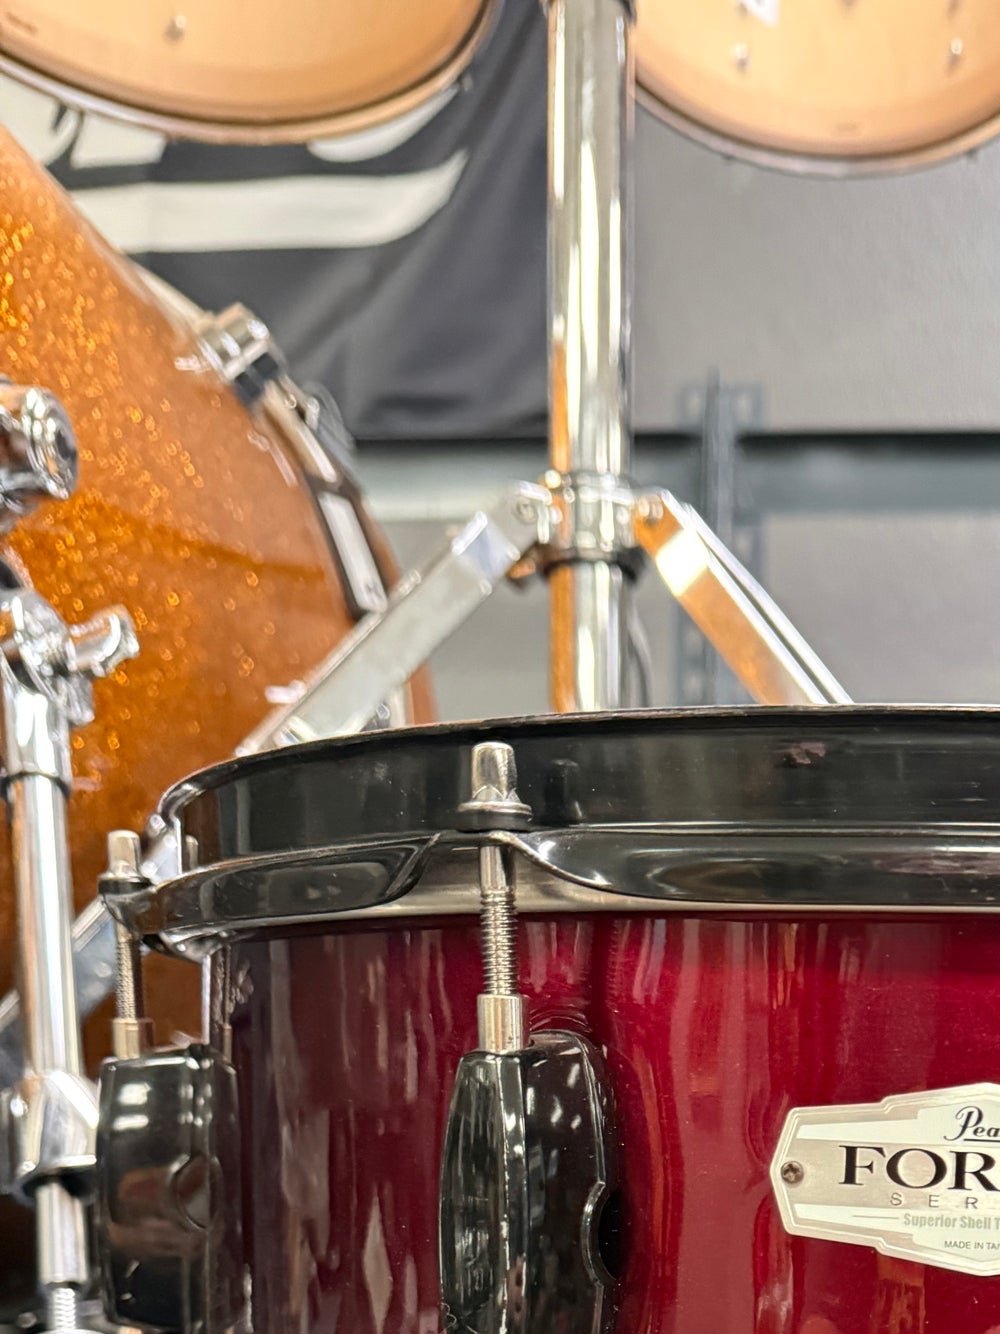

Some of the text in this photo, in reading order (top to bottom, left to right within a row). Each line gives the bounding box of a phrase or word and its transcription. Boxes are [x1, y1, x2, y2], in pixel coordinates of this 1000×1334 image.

[903, 1212, 957, 1229] Superior
[960, 1215, 992, 1231] Shell
[944, 1240, 971, 1250] MADE
[974, 1241, 984, 1251] IN
